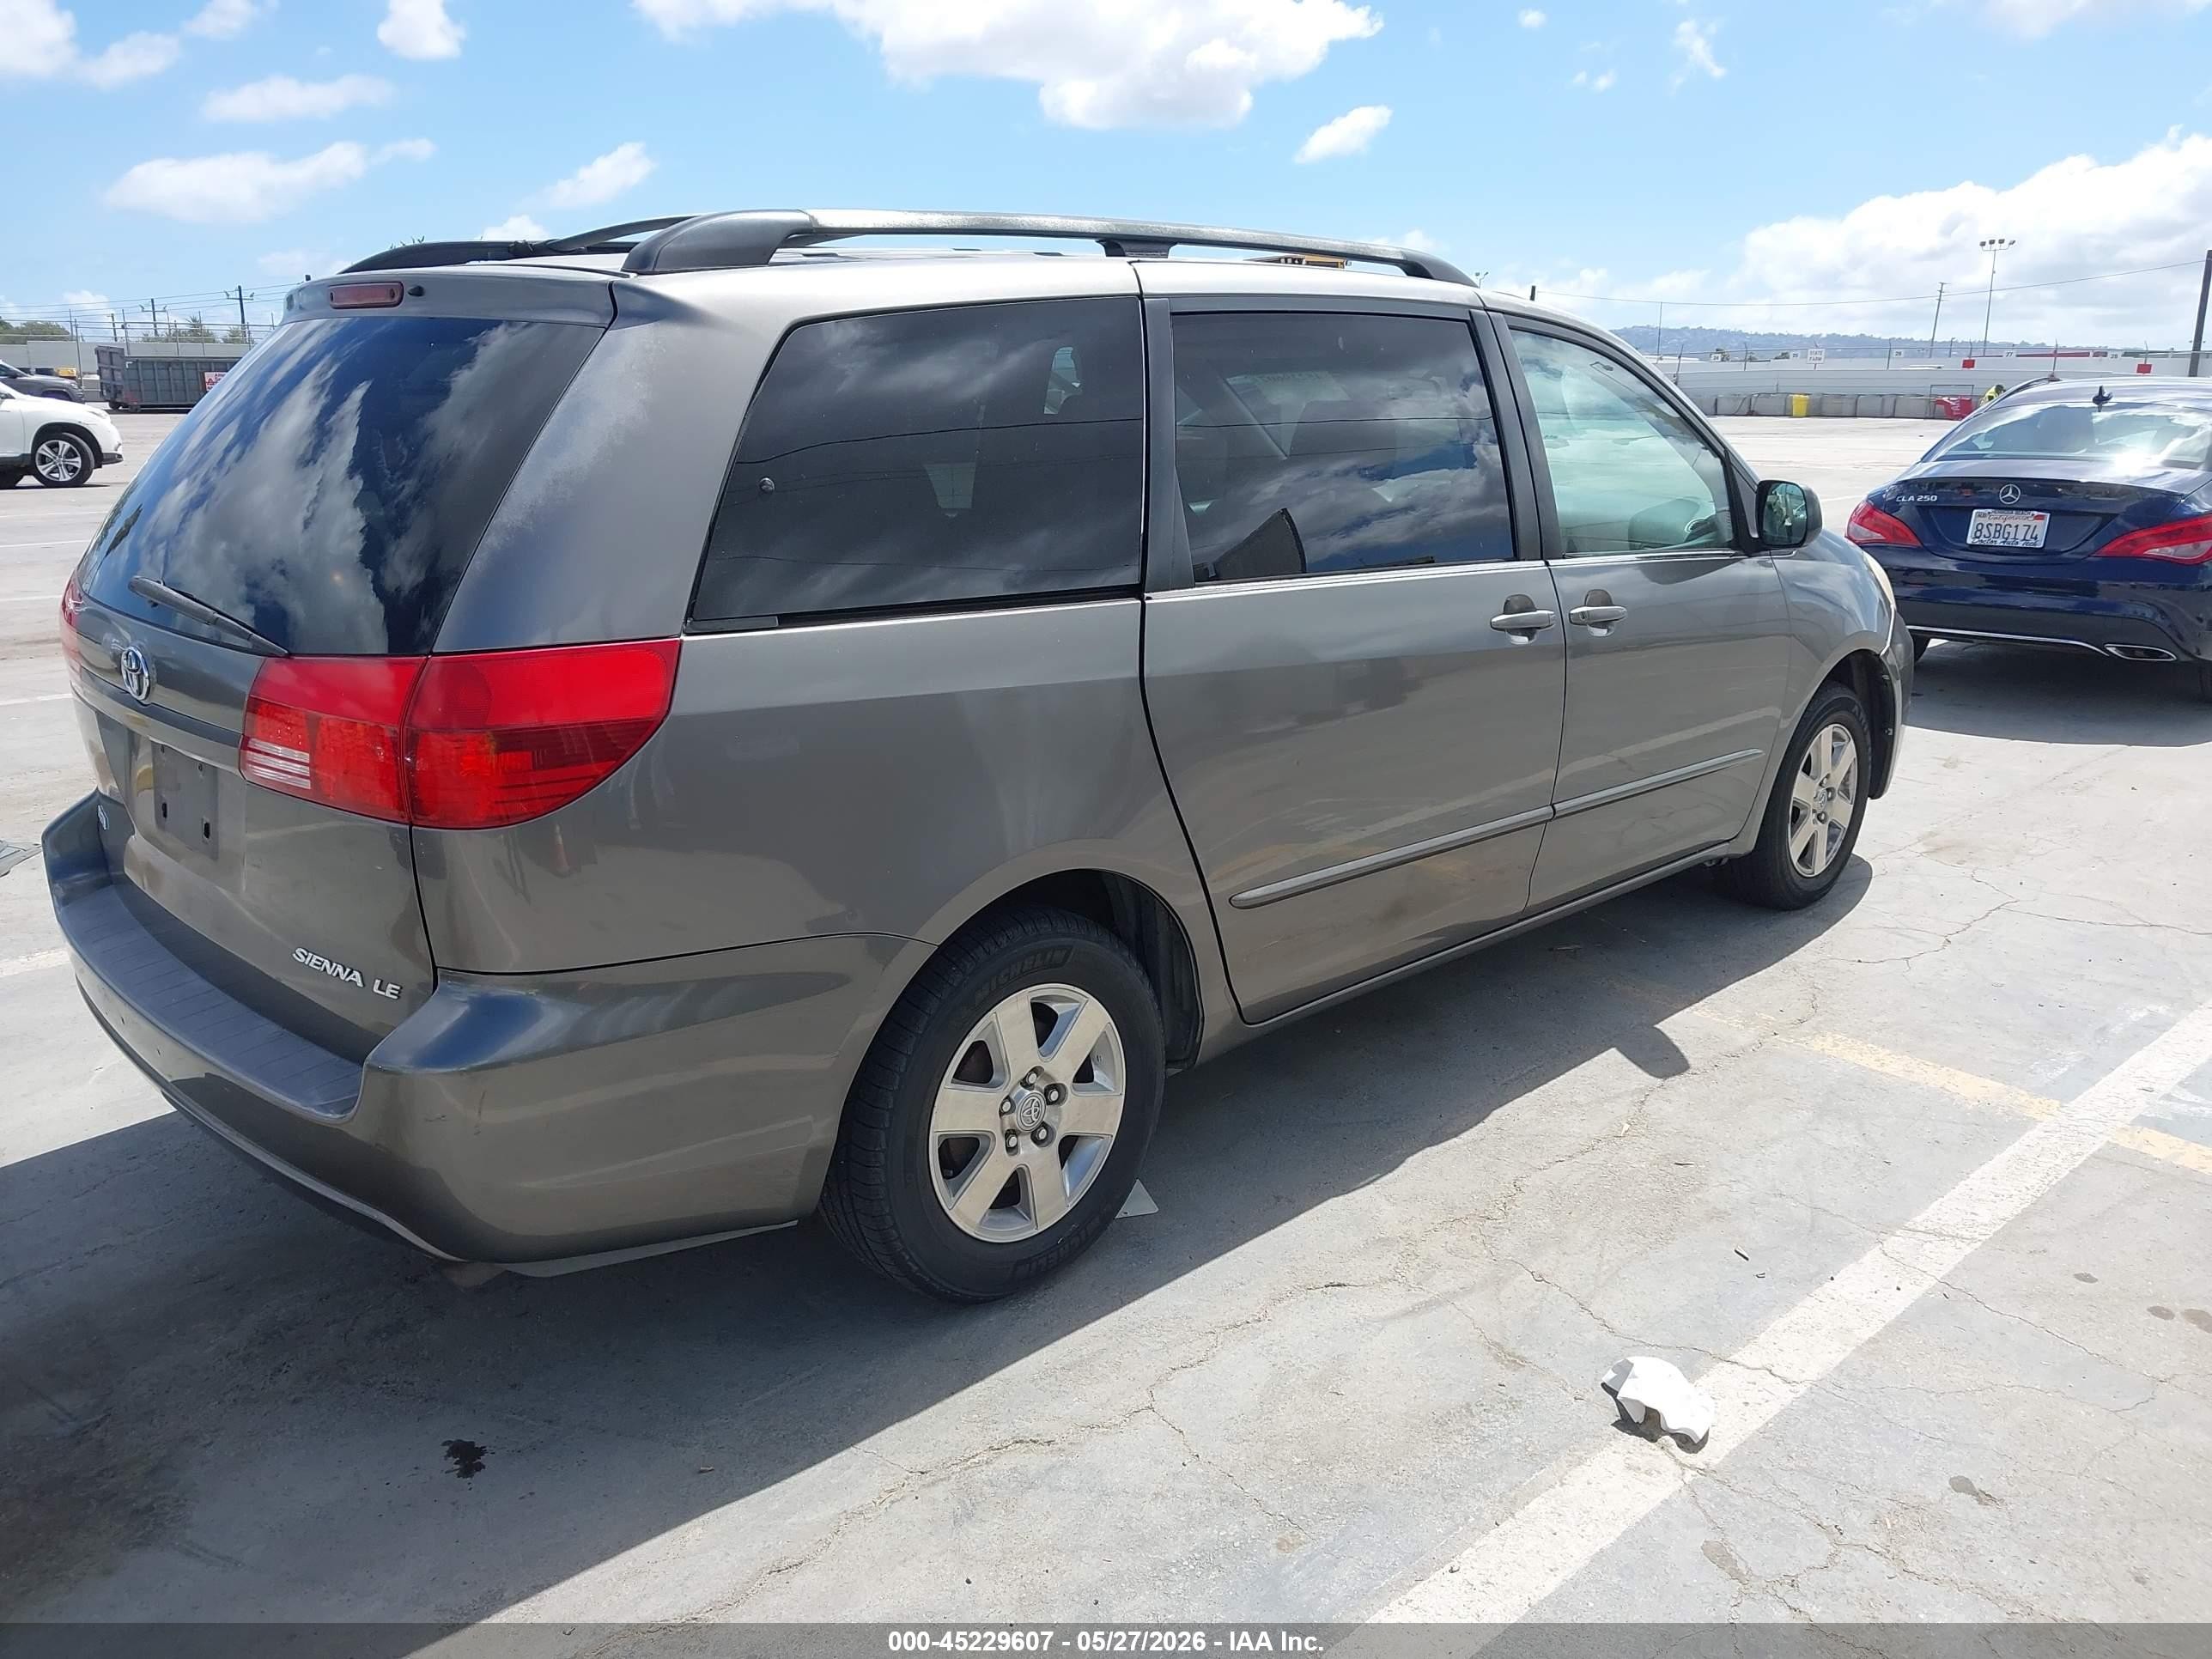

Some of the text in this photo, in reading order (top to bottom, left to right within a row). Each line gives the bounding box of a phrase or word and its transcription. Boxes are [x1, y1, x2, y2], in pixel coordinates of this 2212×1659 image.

[1974, 522, 2039, 541] 8SBG174
[292, 947, 401, 1000] SIENNA LE
